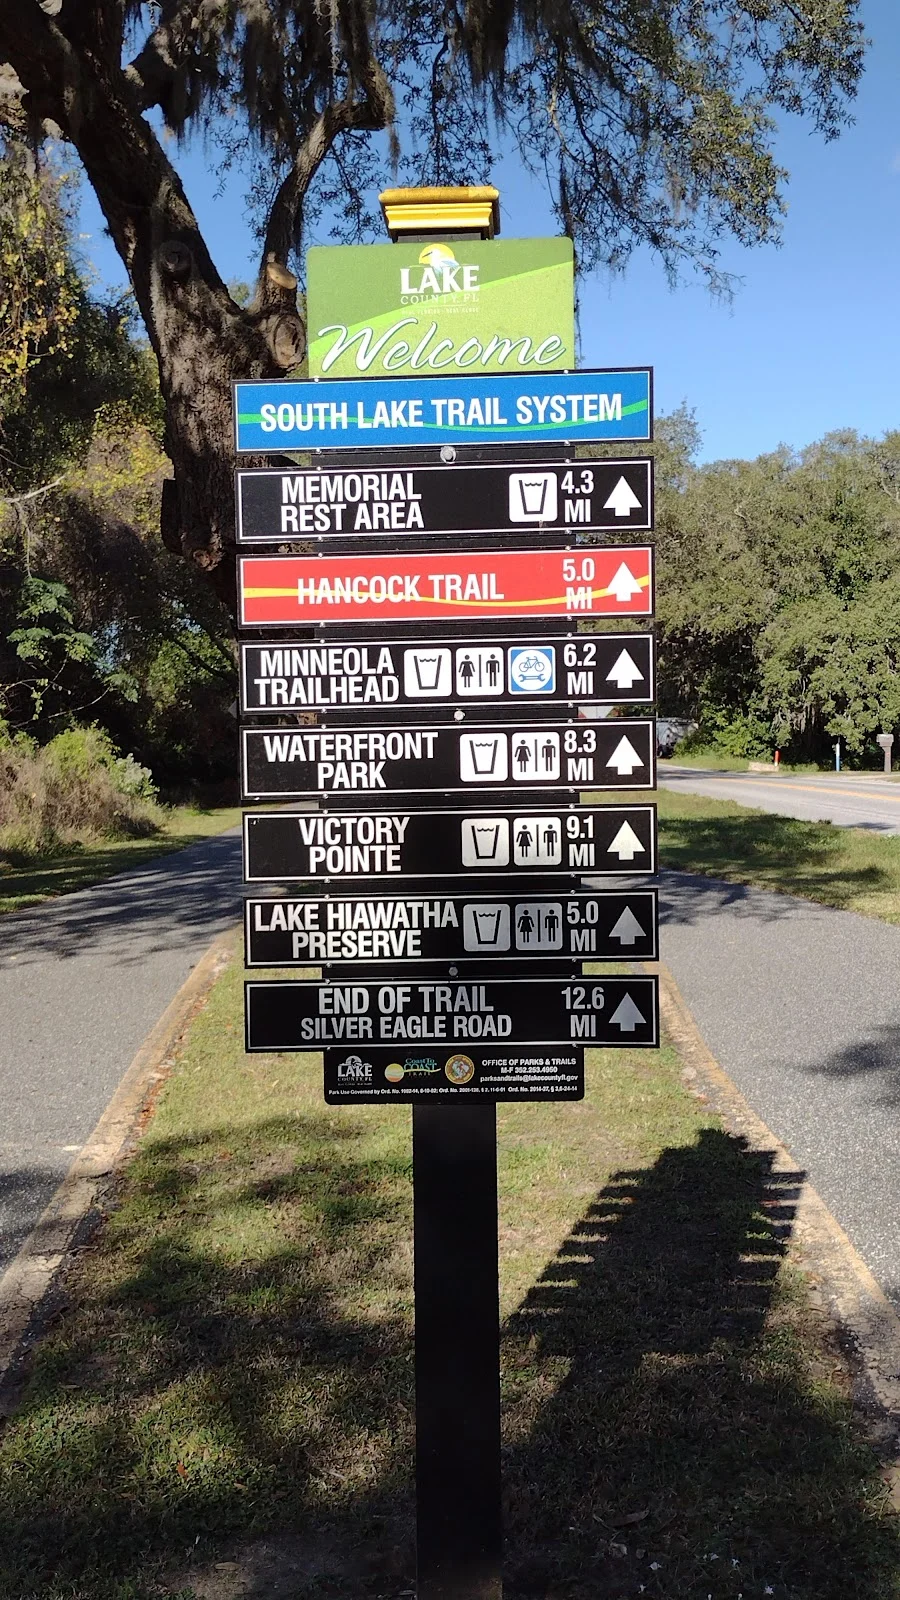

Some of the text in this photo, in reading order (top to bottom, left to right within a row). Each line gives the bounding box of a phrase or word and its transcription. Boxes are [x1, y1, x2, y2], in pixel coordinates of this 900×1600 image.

[400, 265, 480, 294] LAKE
[463, 293, 480, 303] FL
[317, 318, 567, 373] Welcome
[260, 393, 622, 432] SOUTH LAKE TRAIL SYSTEM
[281, 472, 422, 505] MEMORIAL
[561, 470, 594, 496] 4.3
[281, 501, 424, 533] REST AREA
[564, 499, 592, 523] MI
[562, 558, 595, 582] 5.0
[297, 573, 505, 605] HANCOCK TRAIL
[566, 587, 593, 610] MI
[260, 647, 394, 677] MINNEOLA
[563, 642, 596, 667] 6.2
[254, 676, 399, 705] TRAILHEAD
[567, 671, 594, 695] MI
[263, 731, 439, 762] WATERFRONT
[564, 729, 596, 754] 8.3
[317, 761, 387, 789] PARK
[567, 757, 593, 781] MI
[298, 816, 410, 845] VICTORY
[566, 815, 594, 840] 9.1
[309, 845, 401, 873] POINTE
[568, 843, 595, 867] MI
[255, 900, 459, 932] LAKE HIAWATHA
[566, 900, 599, 925] 5.0
[292, 929, 422, 958] PRESERVE
[570, 928, 596, 952] MI
[318, 986, 494, 1014] END OF TRAIL
[561, 986, 605, 1010] 12.6
[300, 1013, 512, 1041] SILVER EAGLE ROAD
[570, 1013, 596, 1037] MI
[338, 1064, 372, 1077] LAKE
[404, 1063, 438, 1072] COAST
